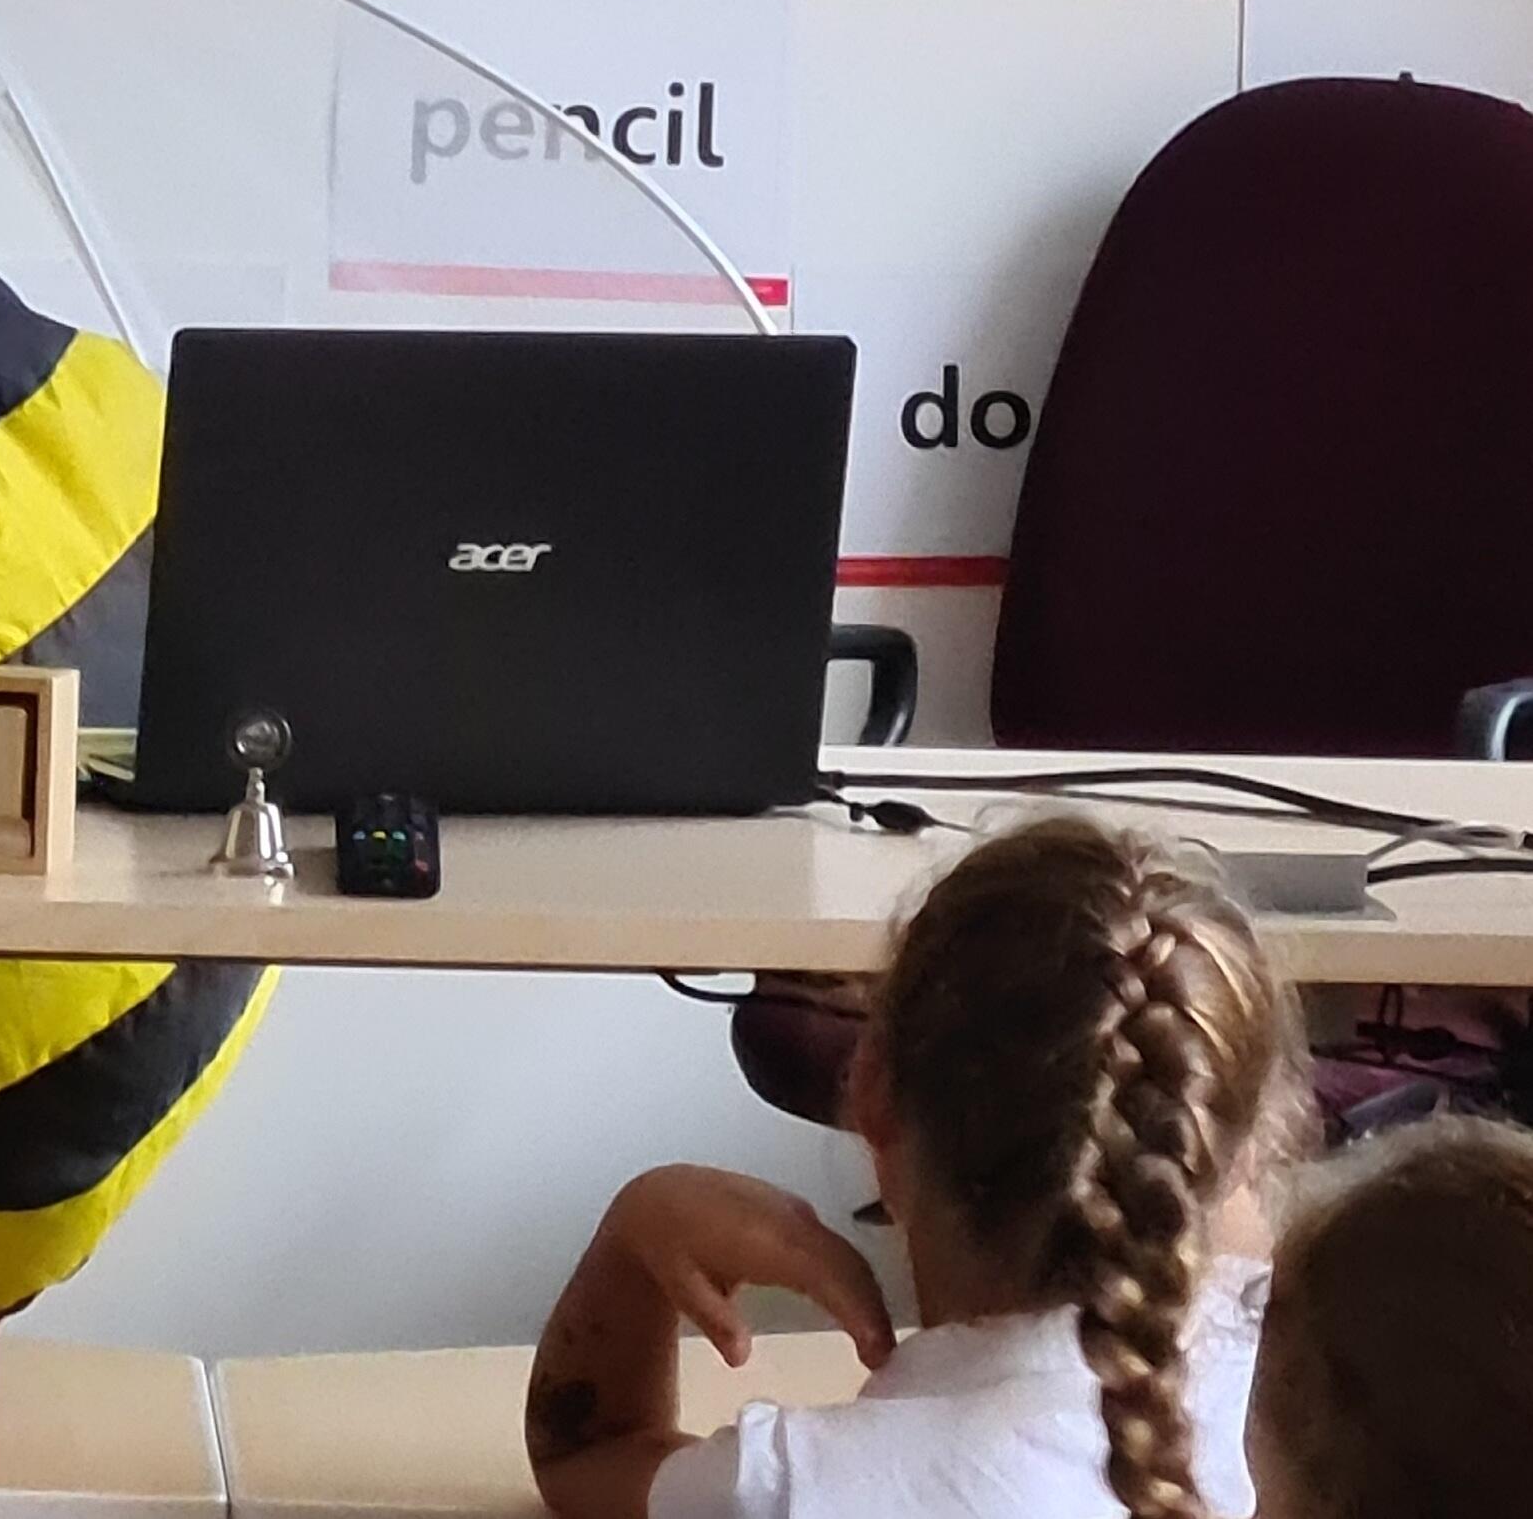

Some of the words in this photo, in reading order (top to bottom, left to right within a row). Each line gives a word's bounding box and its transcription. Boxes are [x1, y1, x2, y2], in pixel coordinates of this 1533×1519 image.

[411, 83, 725, 185] pencil
[900, 364, 1032, 450] do
[448, 543, 552, 572] acer
